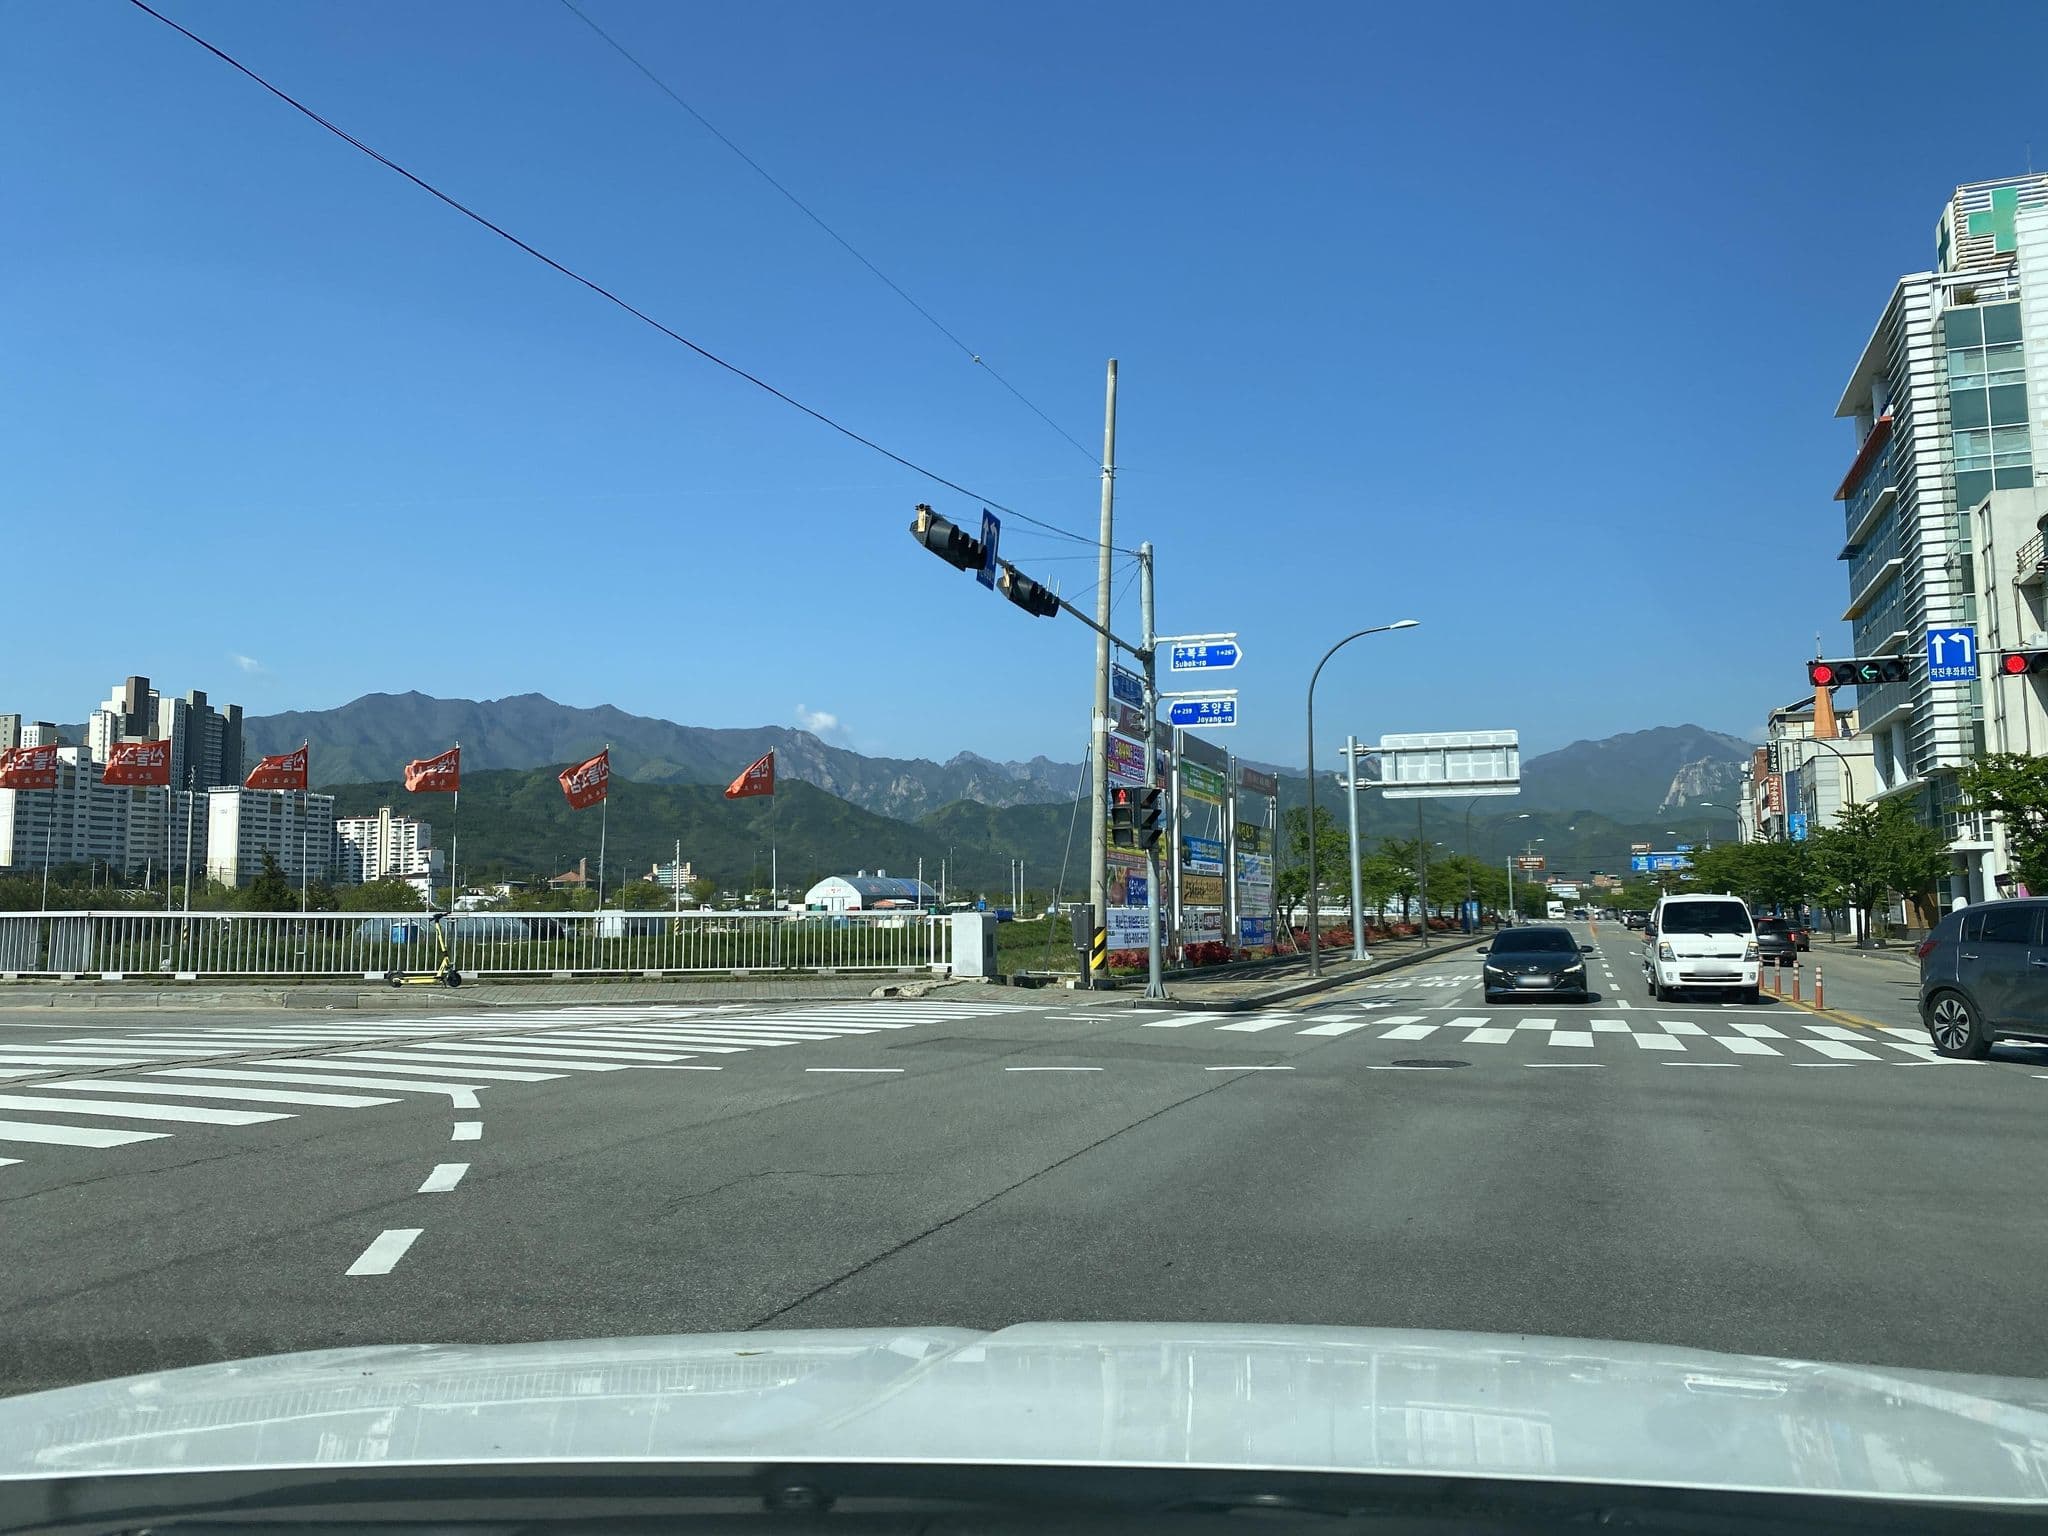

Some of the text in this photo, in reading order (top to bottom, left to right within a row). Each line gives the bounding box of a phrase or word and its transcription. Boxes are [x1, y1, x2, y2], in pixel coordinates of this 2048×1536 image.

[1176, 646, 1207, 658] 수복로
[1175, 660, 1207, 668] Subok-ro
[1931, 665, 1975, 678] 직진후좌회전
[1200, 702, 1232, 715] 조양로
[1197, 716, 1233, 725] Joyang-ro
